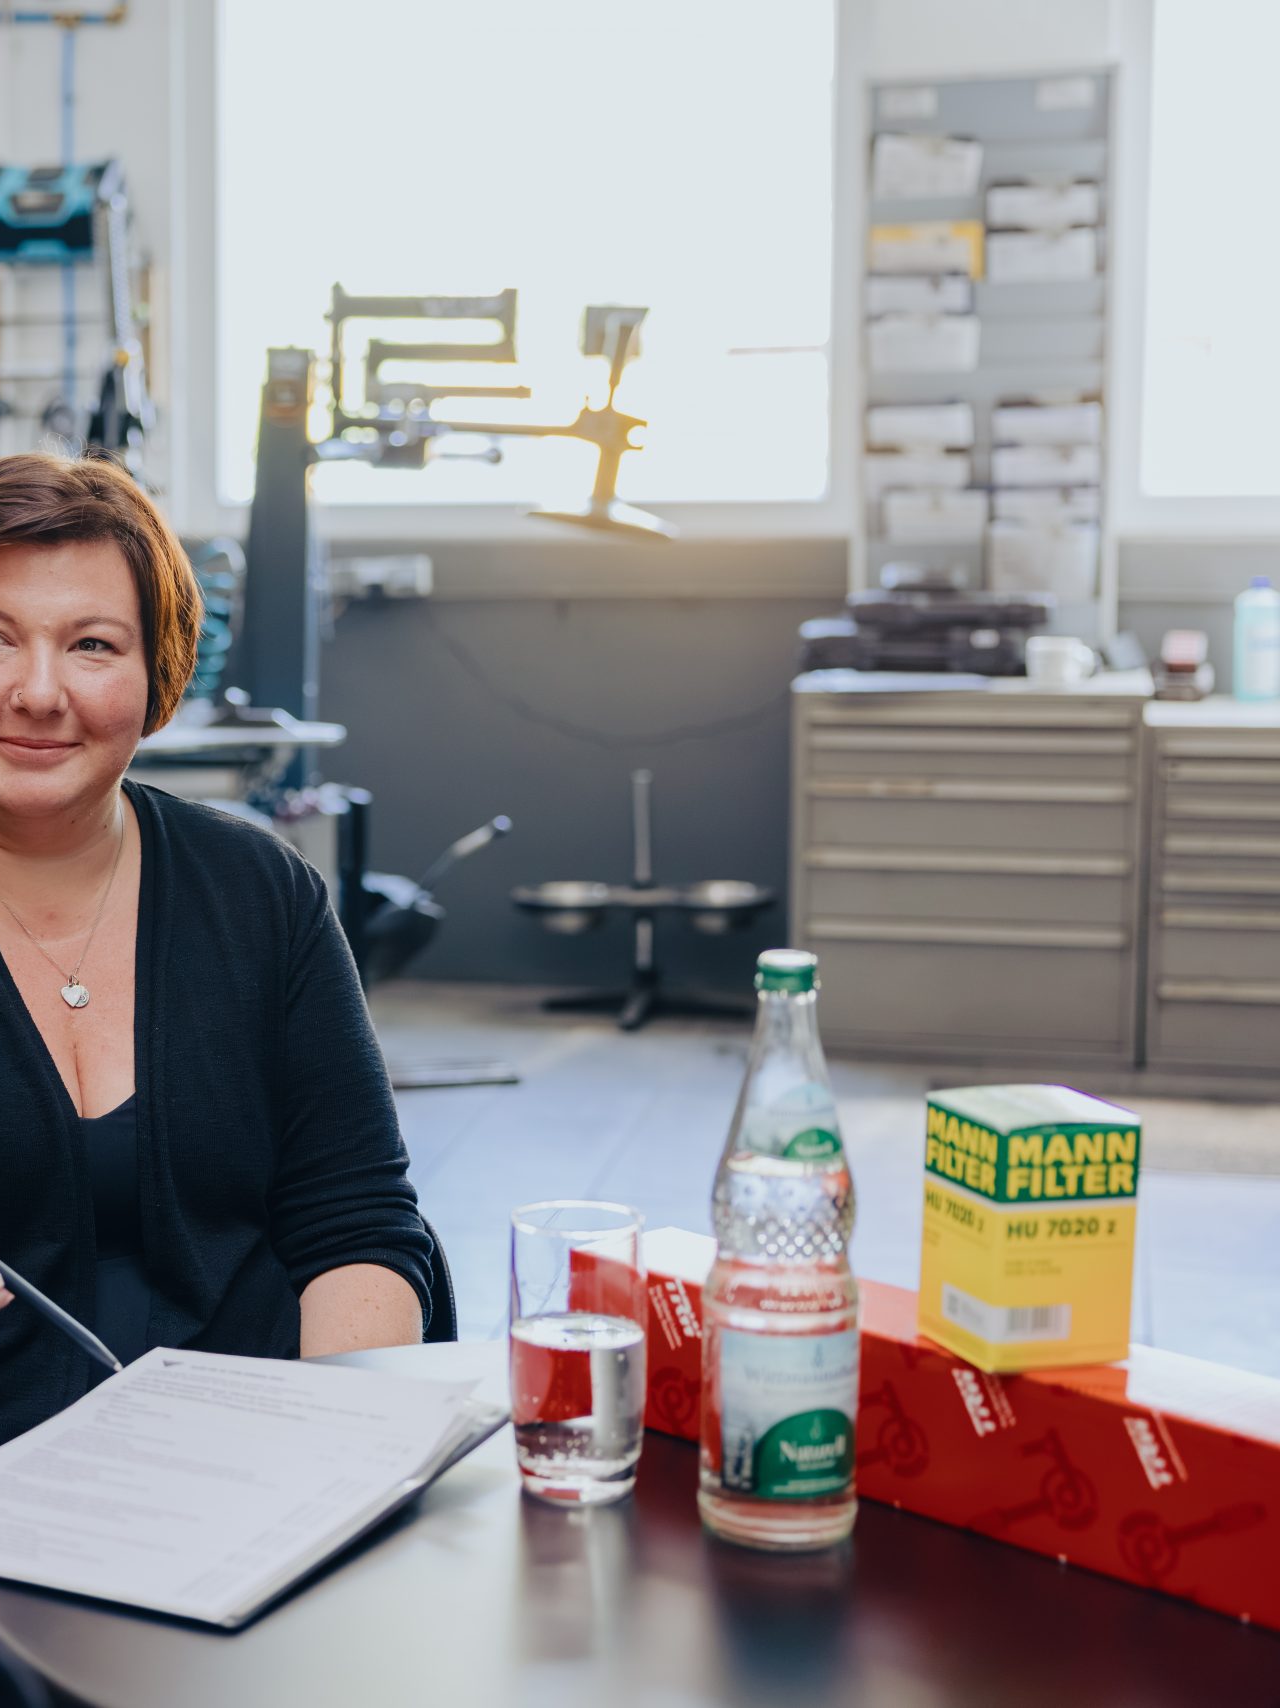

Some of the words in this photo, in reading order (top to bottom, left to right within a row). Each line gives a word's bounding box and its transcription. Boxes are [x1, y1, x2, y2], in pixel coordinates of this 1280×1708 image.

[927, 1105, 998, 1165] MANN
[1008, 1131, 1137, 1167] MANN
[925, 1138, 996, 1197] FILTER
[1006, 1162, 1134, 1199] FILTER
[1007, 1219, 1039, 1240] HU
[1047, 1216, 1100, 1238] 7020
